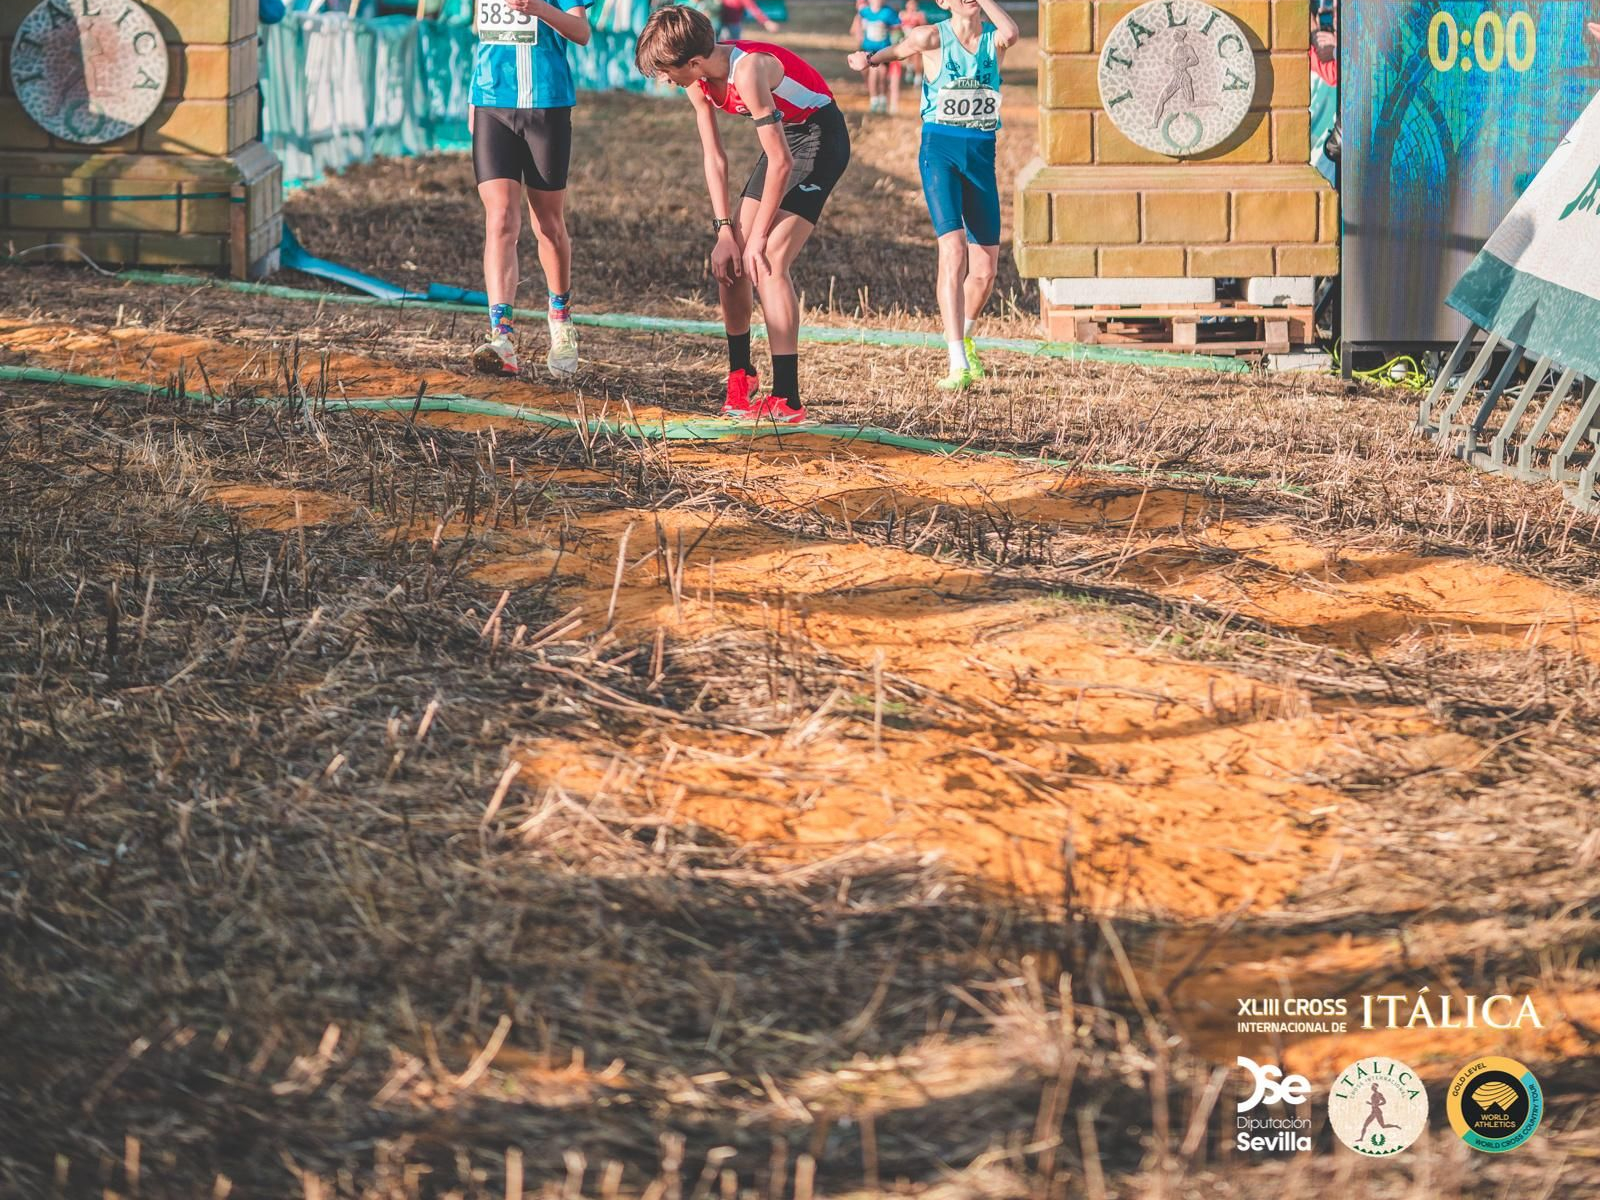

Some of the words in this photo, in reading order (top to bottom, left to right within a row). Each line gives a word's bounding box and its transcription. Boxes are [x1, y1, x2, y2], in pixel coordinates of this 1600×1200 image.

[1105, 1, 1250, 108] ITALICA
[1427, 10, 1536, 72] 0:00
[943, 97, 996, 116] 8028
